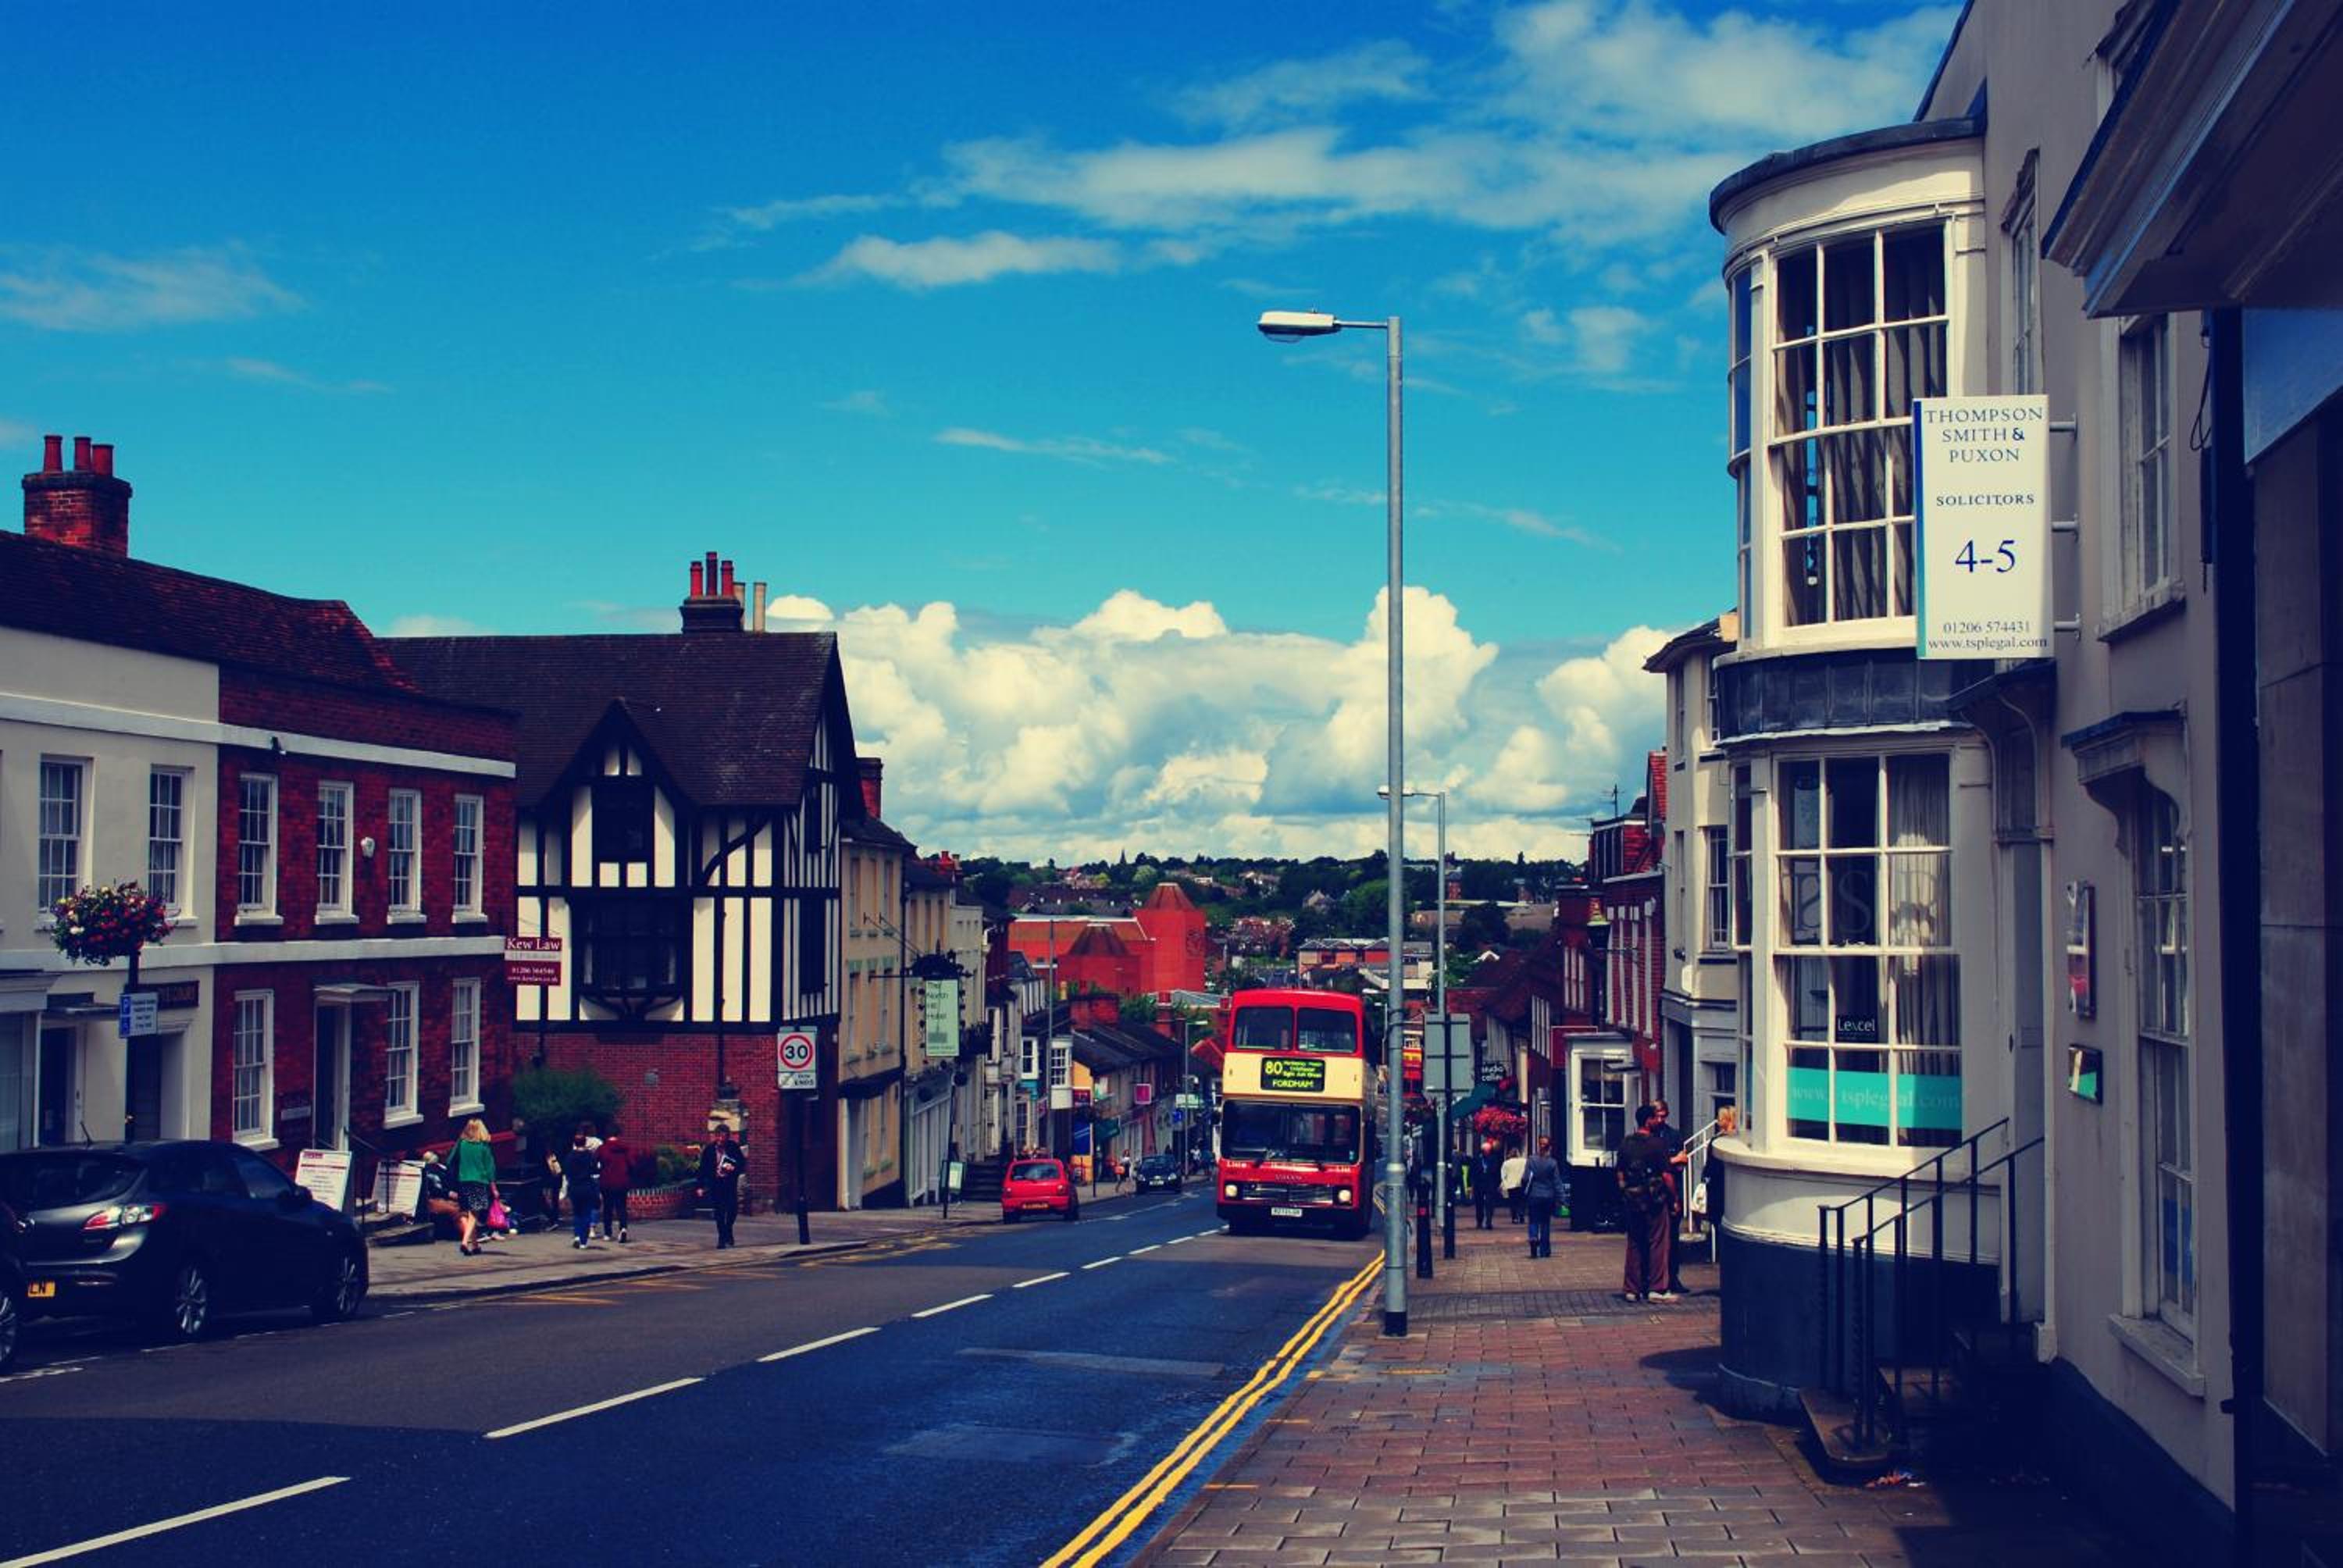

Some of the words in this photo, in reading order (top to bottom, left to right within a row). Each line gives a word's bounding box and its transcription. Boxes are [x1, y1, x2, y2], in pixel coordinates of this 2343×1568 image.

[1925, 407, 2044, 423] THOMPSON
[1942, 428, 2007, 442] SMITH
[2012, 427, 2025, 441] &
[1949, 448, 2020, 463] PUXON
[1936, 494, 2035, 507] SOLICITORS
[1955, 539, 2016, 573] 4-5
[1943, 622, 1981, 633] 01206
[1986, 621, 2031, 633] 574431
[1928, 636, 2047, 651] www.tsplegal.com
[507, 938, 533, 950] Kew
[537, 939, 560, 950] Law
[785, 1045, 808, 1060] 30
[1265, 1061, 1283, 1074] 80
[1272, 1079, 1314, 1088] FORDHAM
